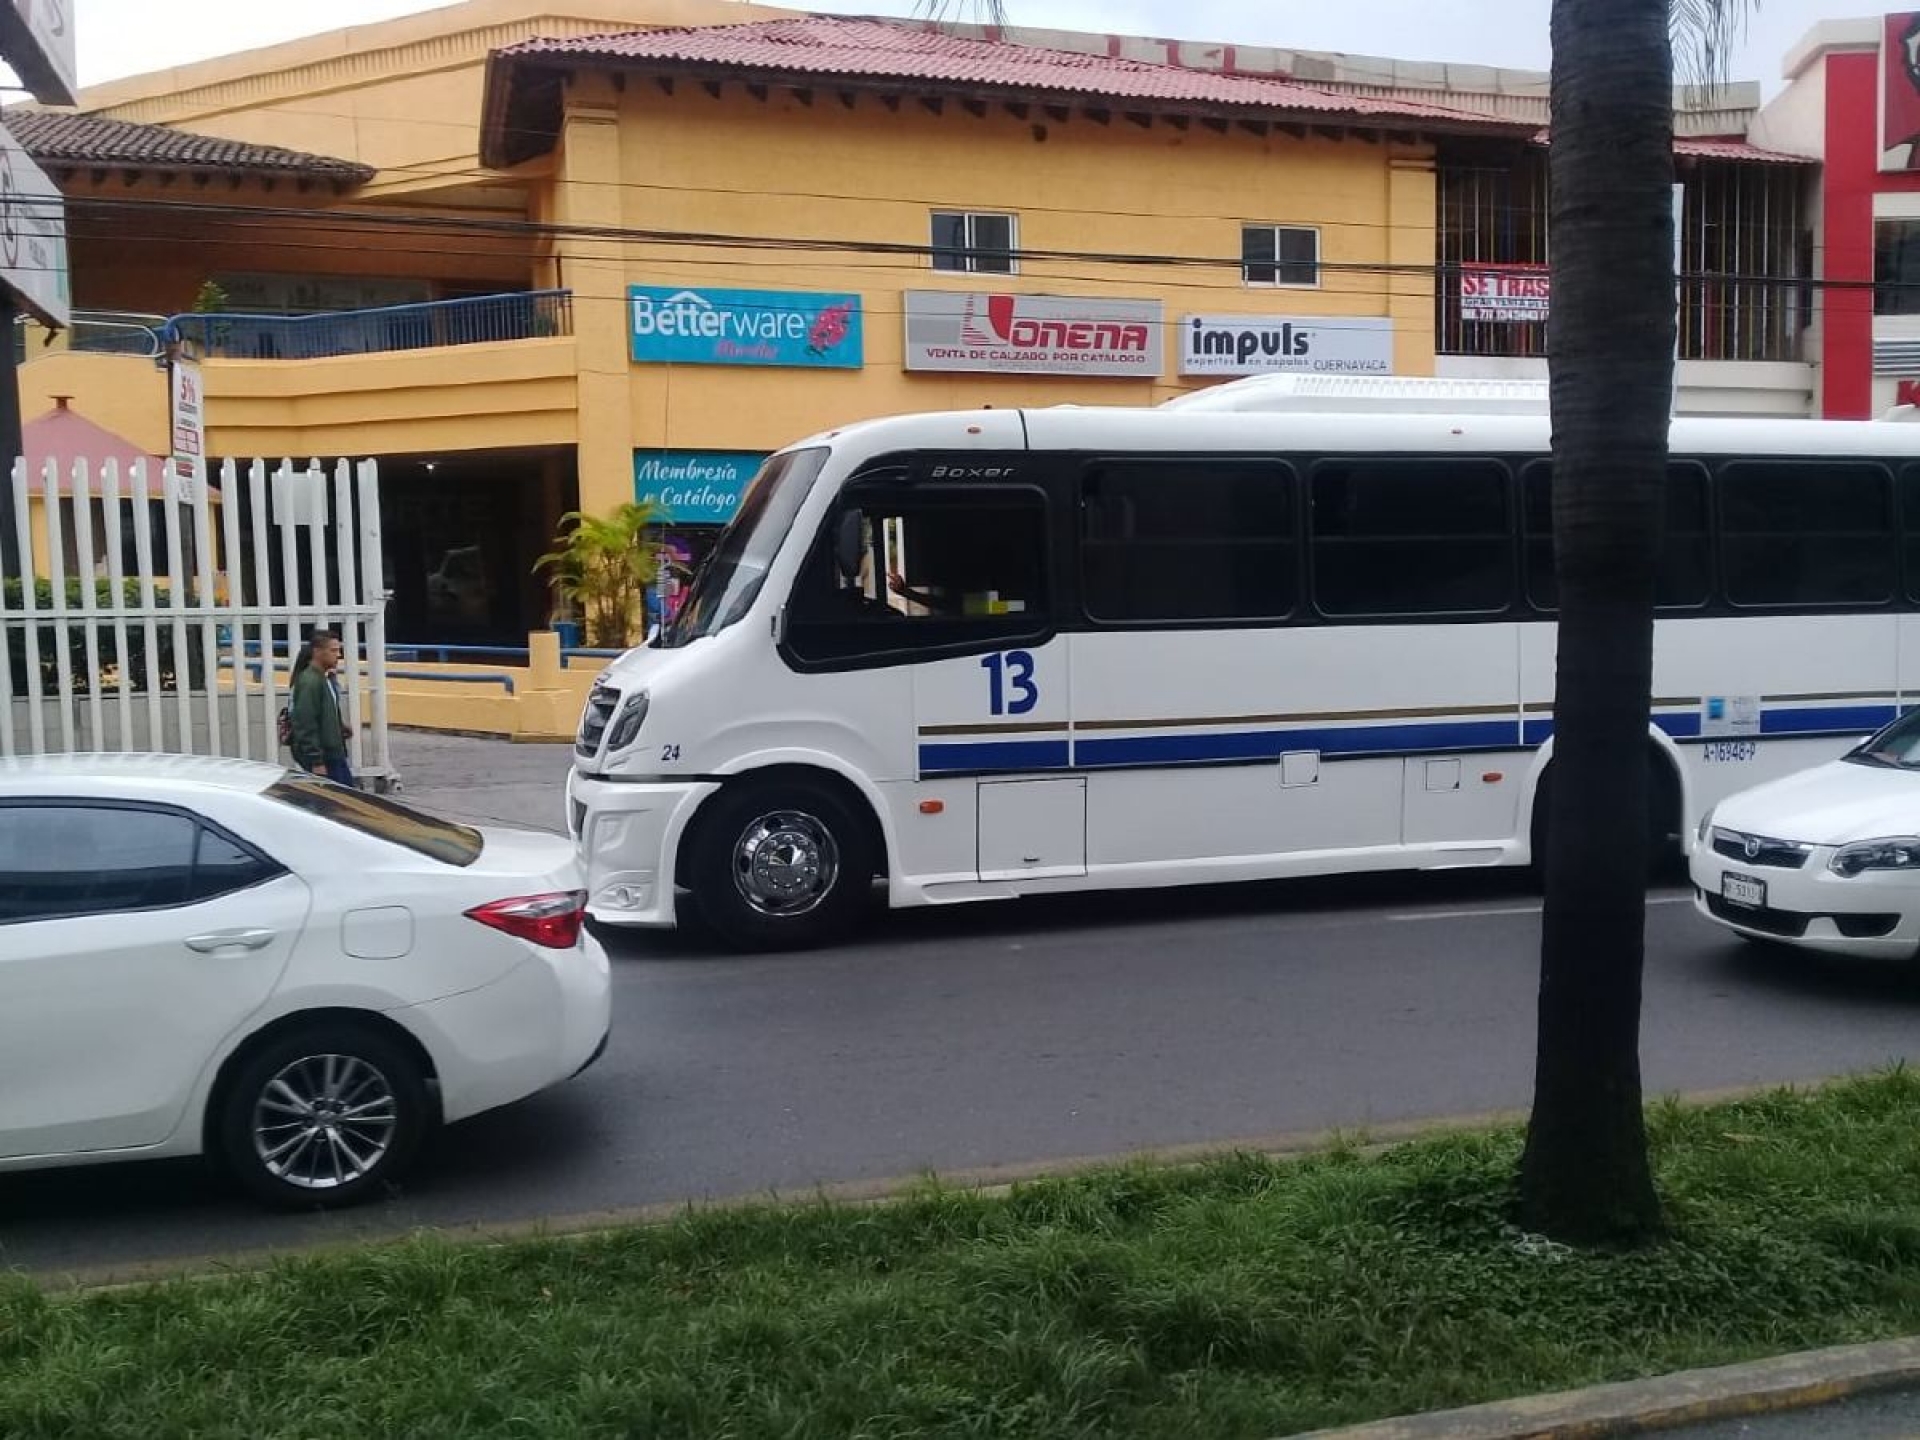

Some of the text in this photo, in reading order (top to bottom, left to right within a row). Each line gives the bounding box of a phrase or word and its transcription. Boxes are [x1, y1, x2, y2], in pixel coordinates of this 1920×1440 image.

[1463, 273, 1489, 295] SE
[634, 292, 805, 338] Betterware
[1192, 318, 1310, 365] impuls
[926, 348, 966, 359] VENTA
[969, 349, 987, 360] DE
[1053, 353, 1079, 363] POR
[638, 459, 738, 482] Membresía
[660, 485, 737, 513] Catálogo
[981, 650, 1038, 715] 13
[661, 744, 681, 761] 24
